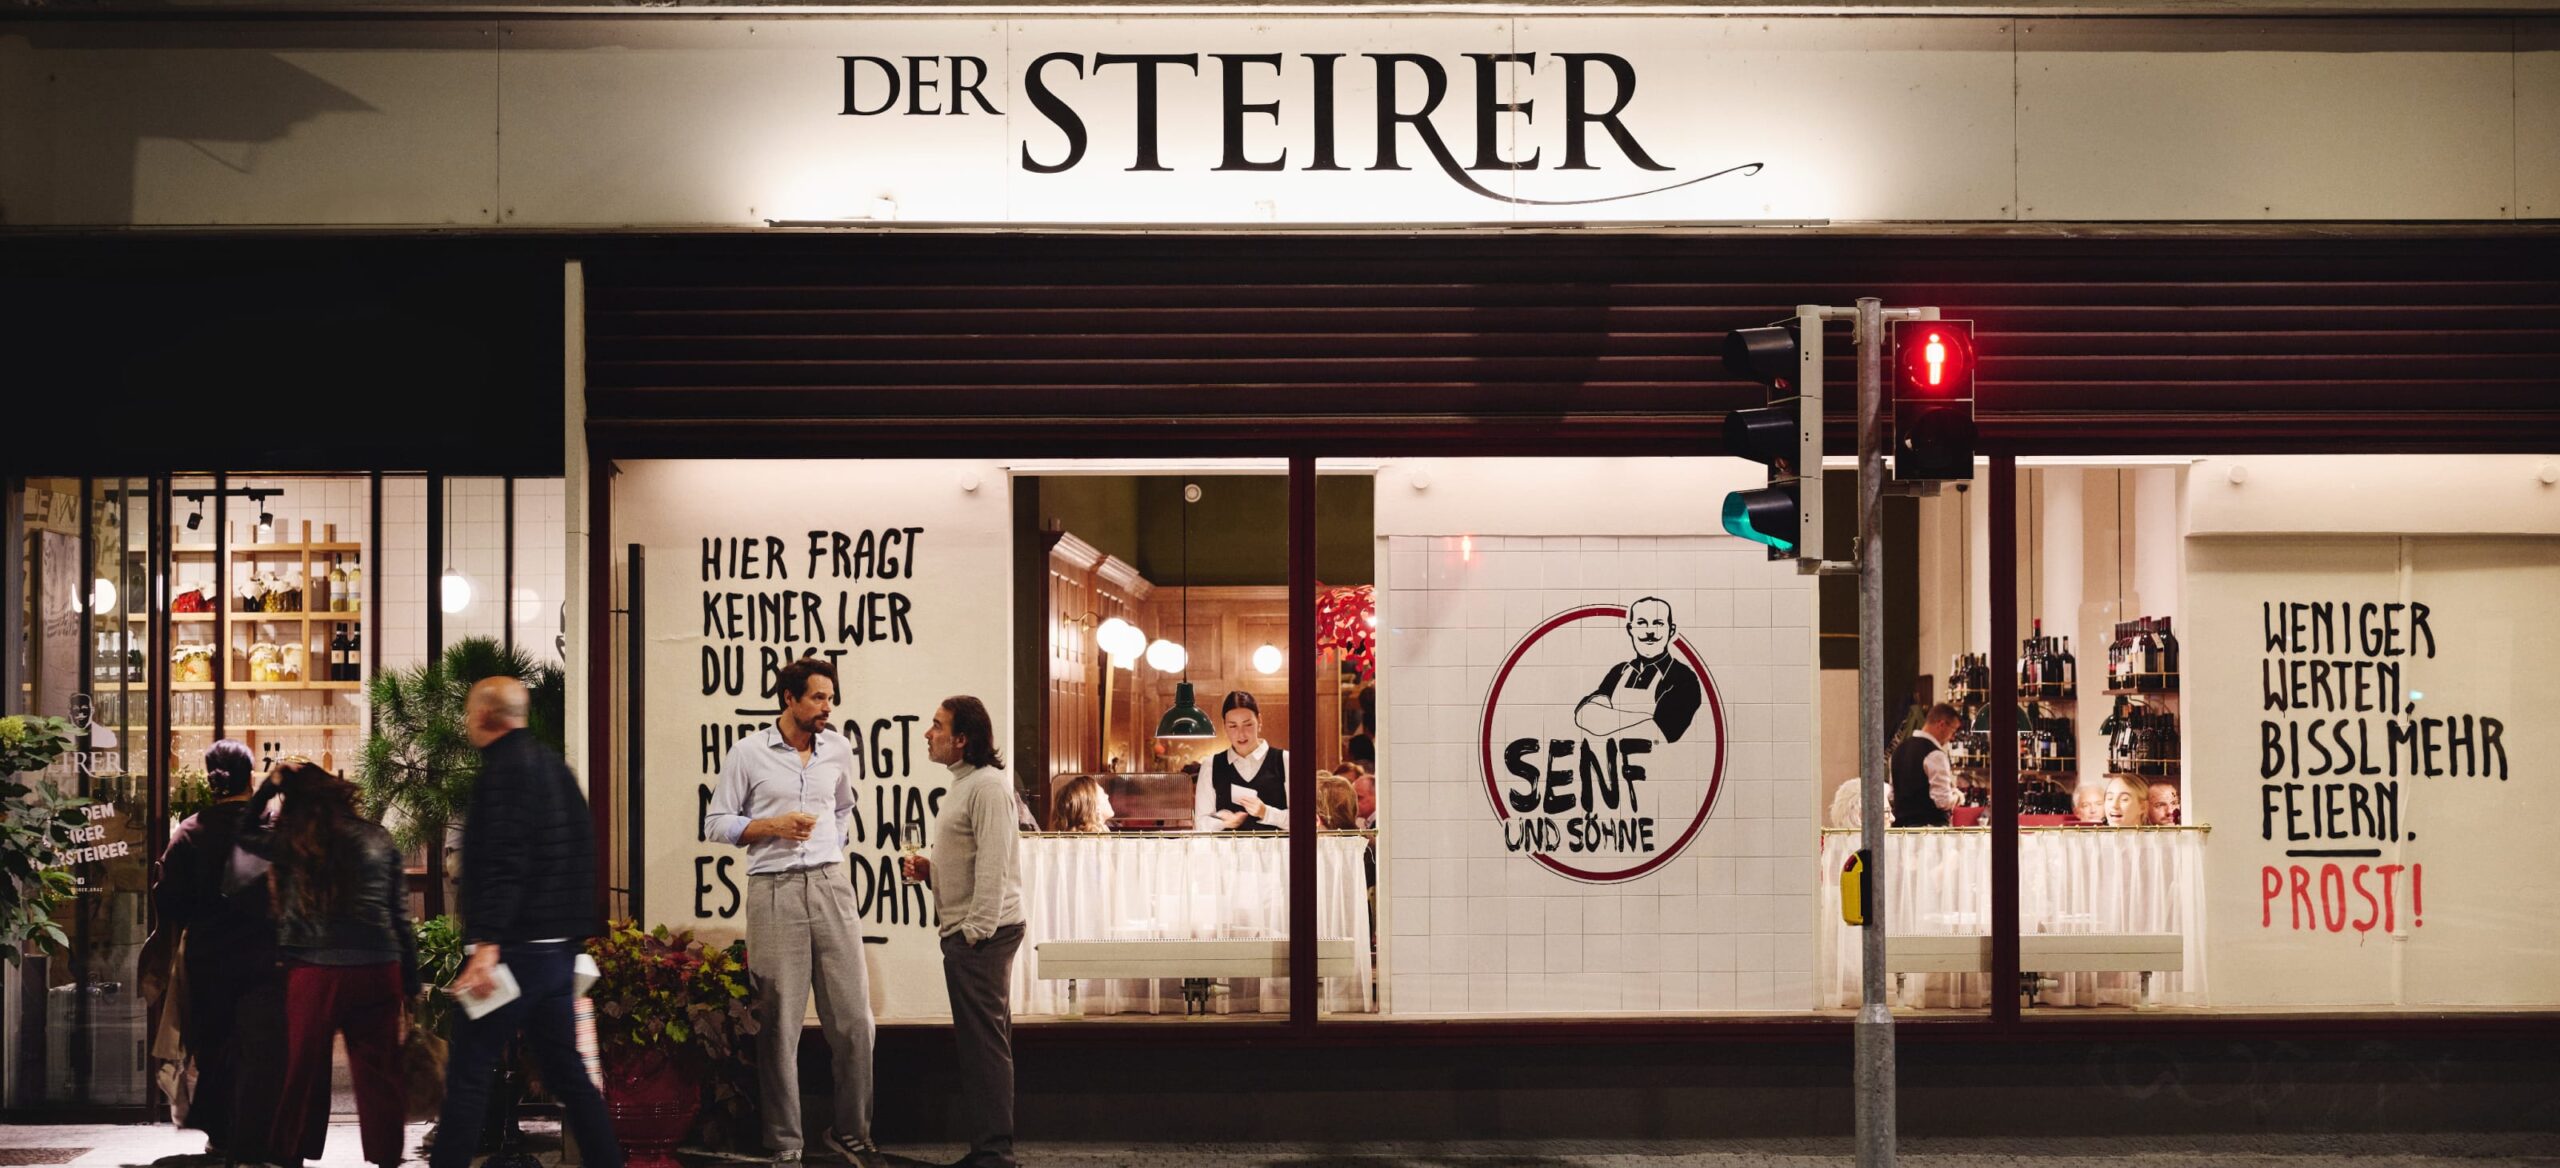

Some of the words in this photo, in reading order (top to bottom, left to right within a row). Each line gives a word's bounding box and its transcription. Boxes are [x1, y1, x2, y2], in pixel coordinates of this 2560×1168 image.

[837, 54, 1004, 117] DER
[1021, 50, 1765, 205] STEIRER
[701, 536, 788, 582] HIER
[807, 527, 924, 580] FRAGT
[703, 589, 826, 645] KEINER
[838, 590, 914, 647] WER
[2263, 601, 2436, 660] WENIGER
[701, 644, 744, 697] DU
[760, 644, 849, 707] BT
[2262, 657, 2416, 717] WERTEN,
[1503, 737, 1652, 815] SENF
[1504, 816, 1561, 853] UND
[1566, 811, 1655, 853] SÖHNE
[2261, 780, 2417, 843] FEIERN.
[694, 855, 741, 919] ES
[2262, 863, 2423, 933] PROST!
